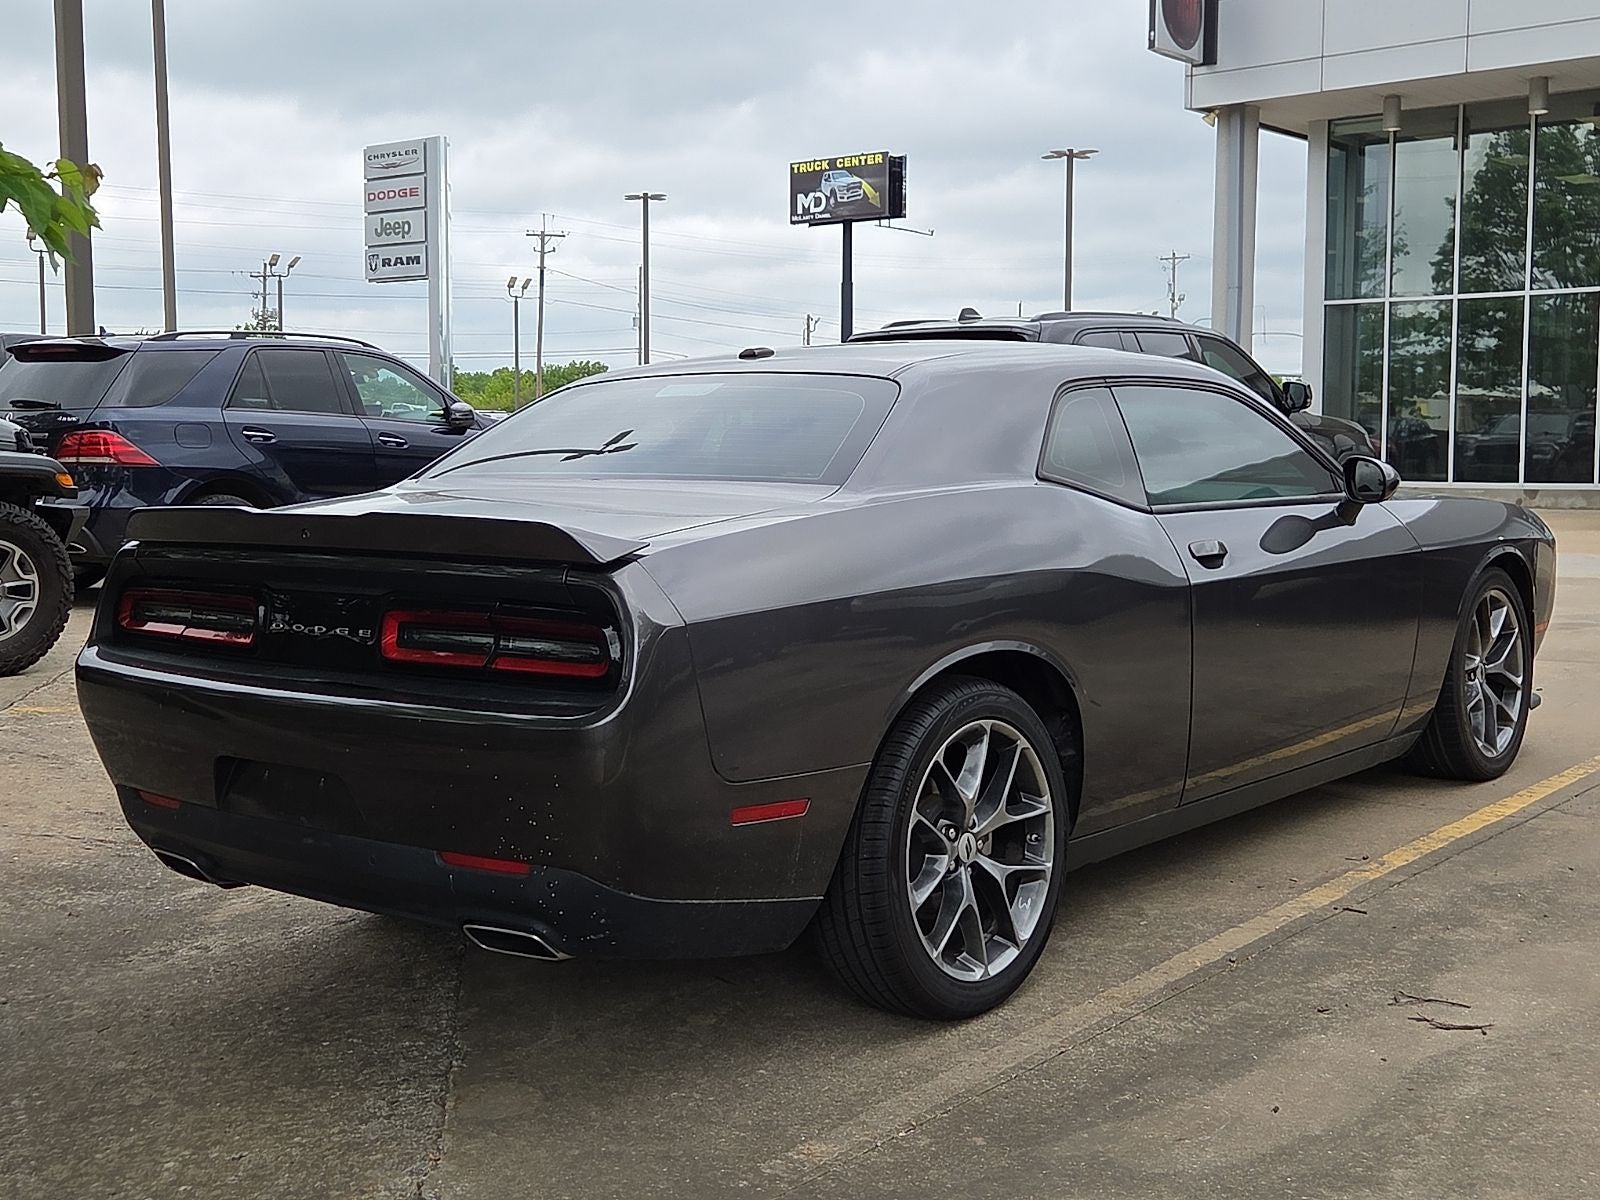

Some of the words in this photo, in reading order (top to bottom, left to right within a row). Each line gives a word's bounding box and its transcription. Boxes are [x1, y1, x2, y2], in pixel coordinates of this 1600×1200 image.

[367, 148, 418, 161] CHRYSLER
[792, 161, 829, 174] TRUCK
[836, 153, 883, 168] CENTER
[367, 187, 420, 202] DODGE
[797, 191, 827, 214] MD
[374, 217, 412, 239] Jeep
[381, 255, 421, 268] RAM
